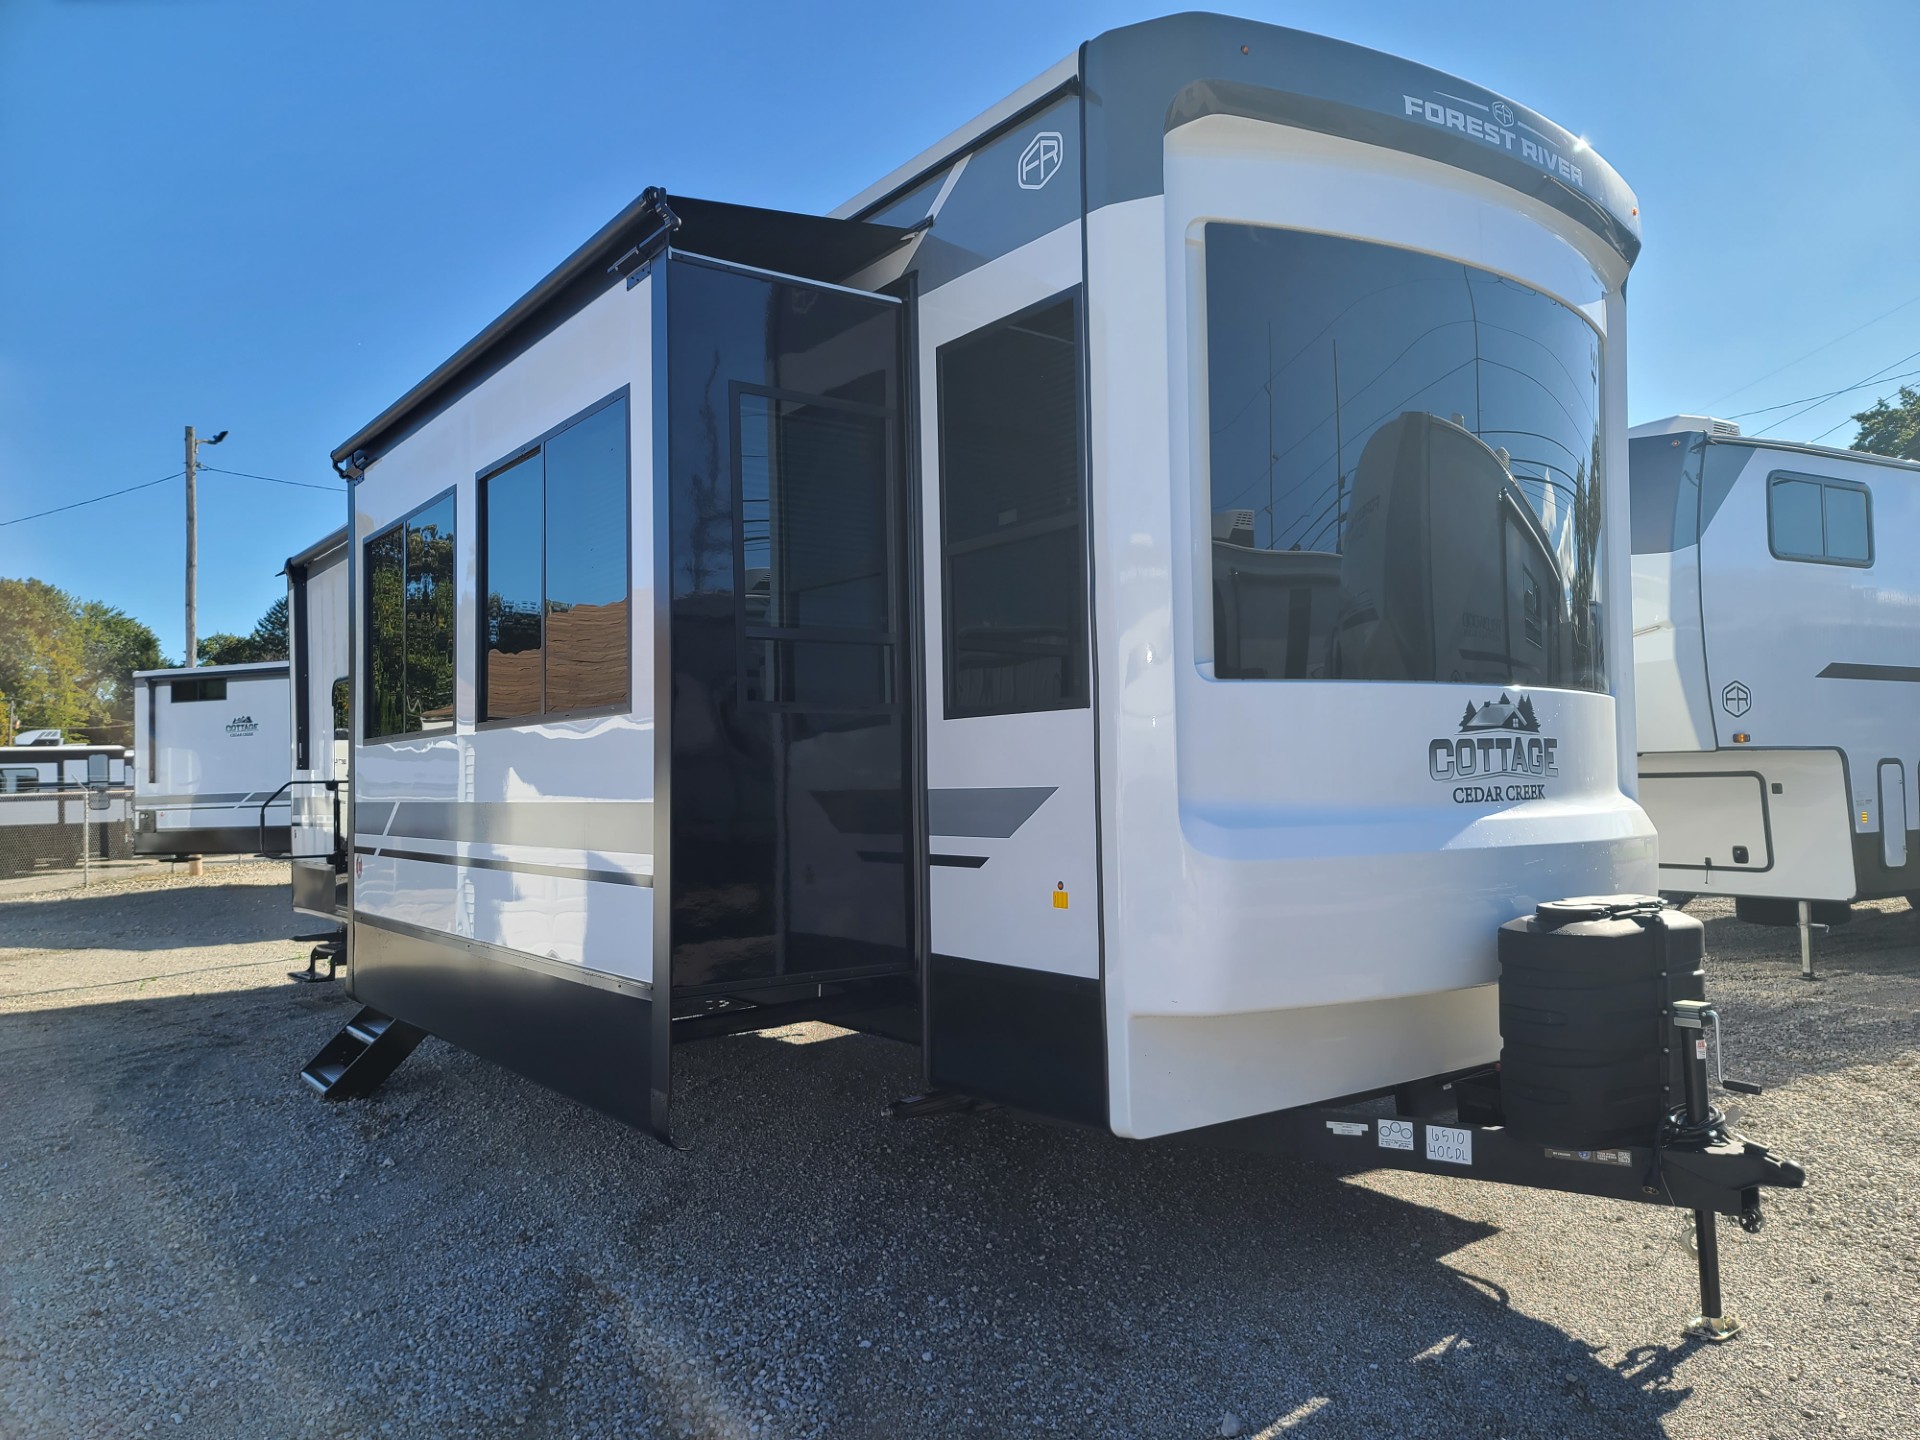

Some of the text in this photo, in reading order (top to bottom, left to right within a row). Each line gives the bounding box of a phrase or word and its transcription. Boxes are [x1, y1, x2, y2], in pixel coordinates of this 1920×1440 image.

[1403, 95, 1583, 187] FOREST RIVER
[226, 724, 259, 732] COTTAGE
[1429, 737, 1558, 781] COTTAGE
[1453, 784, 1545, 803] CEDAR CREEK
[1431, 1127, 1465, 1145] 6510
[1428, 1143, 1468, 1161] 40CDL
